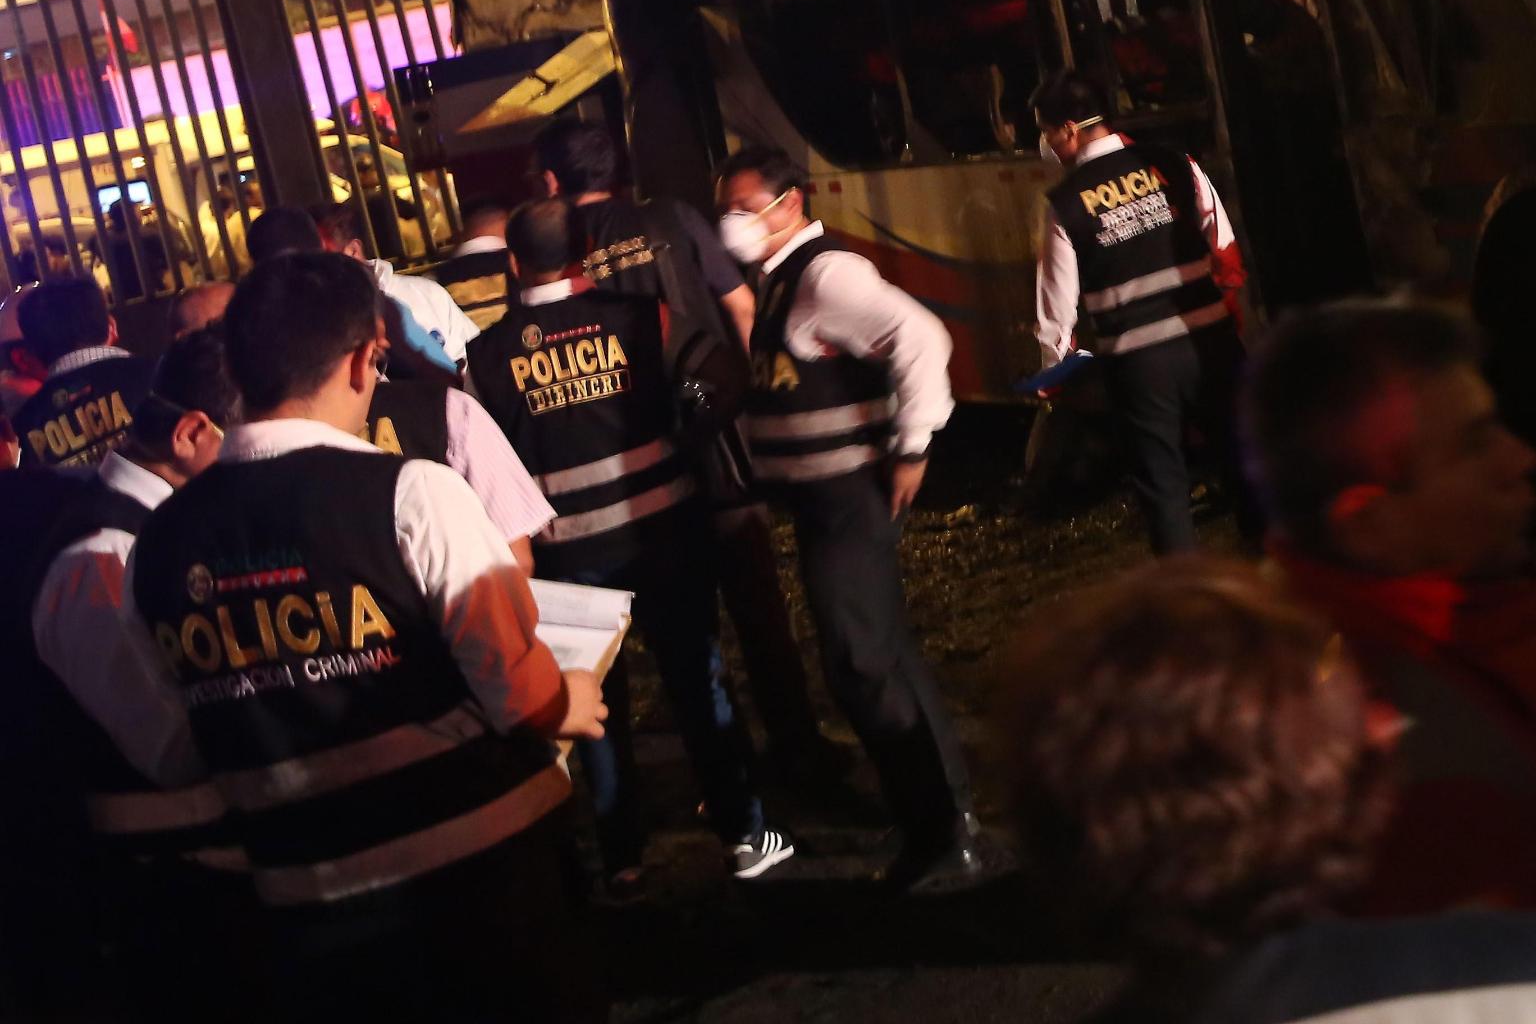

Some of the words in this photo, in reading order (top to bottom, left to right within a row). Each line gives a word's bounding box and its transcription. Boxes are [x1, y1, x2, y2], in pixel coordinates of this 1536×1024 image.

[1080, 167, 1168, 217] POLICIA
[510, 335, 628, 393] POLICIA
[27, 390, 133, 464] POLICIA
[303, 645, 400, 683] CRIMINAL
